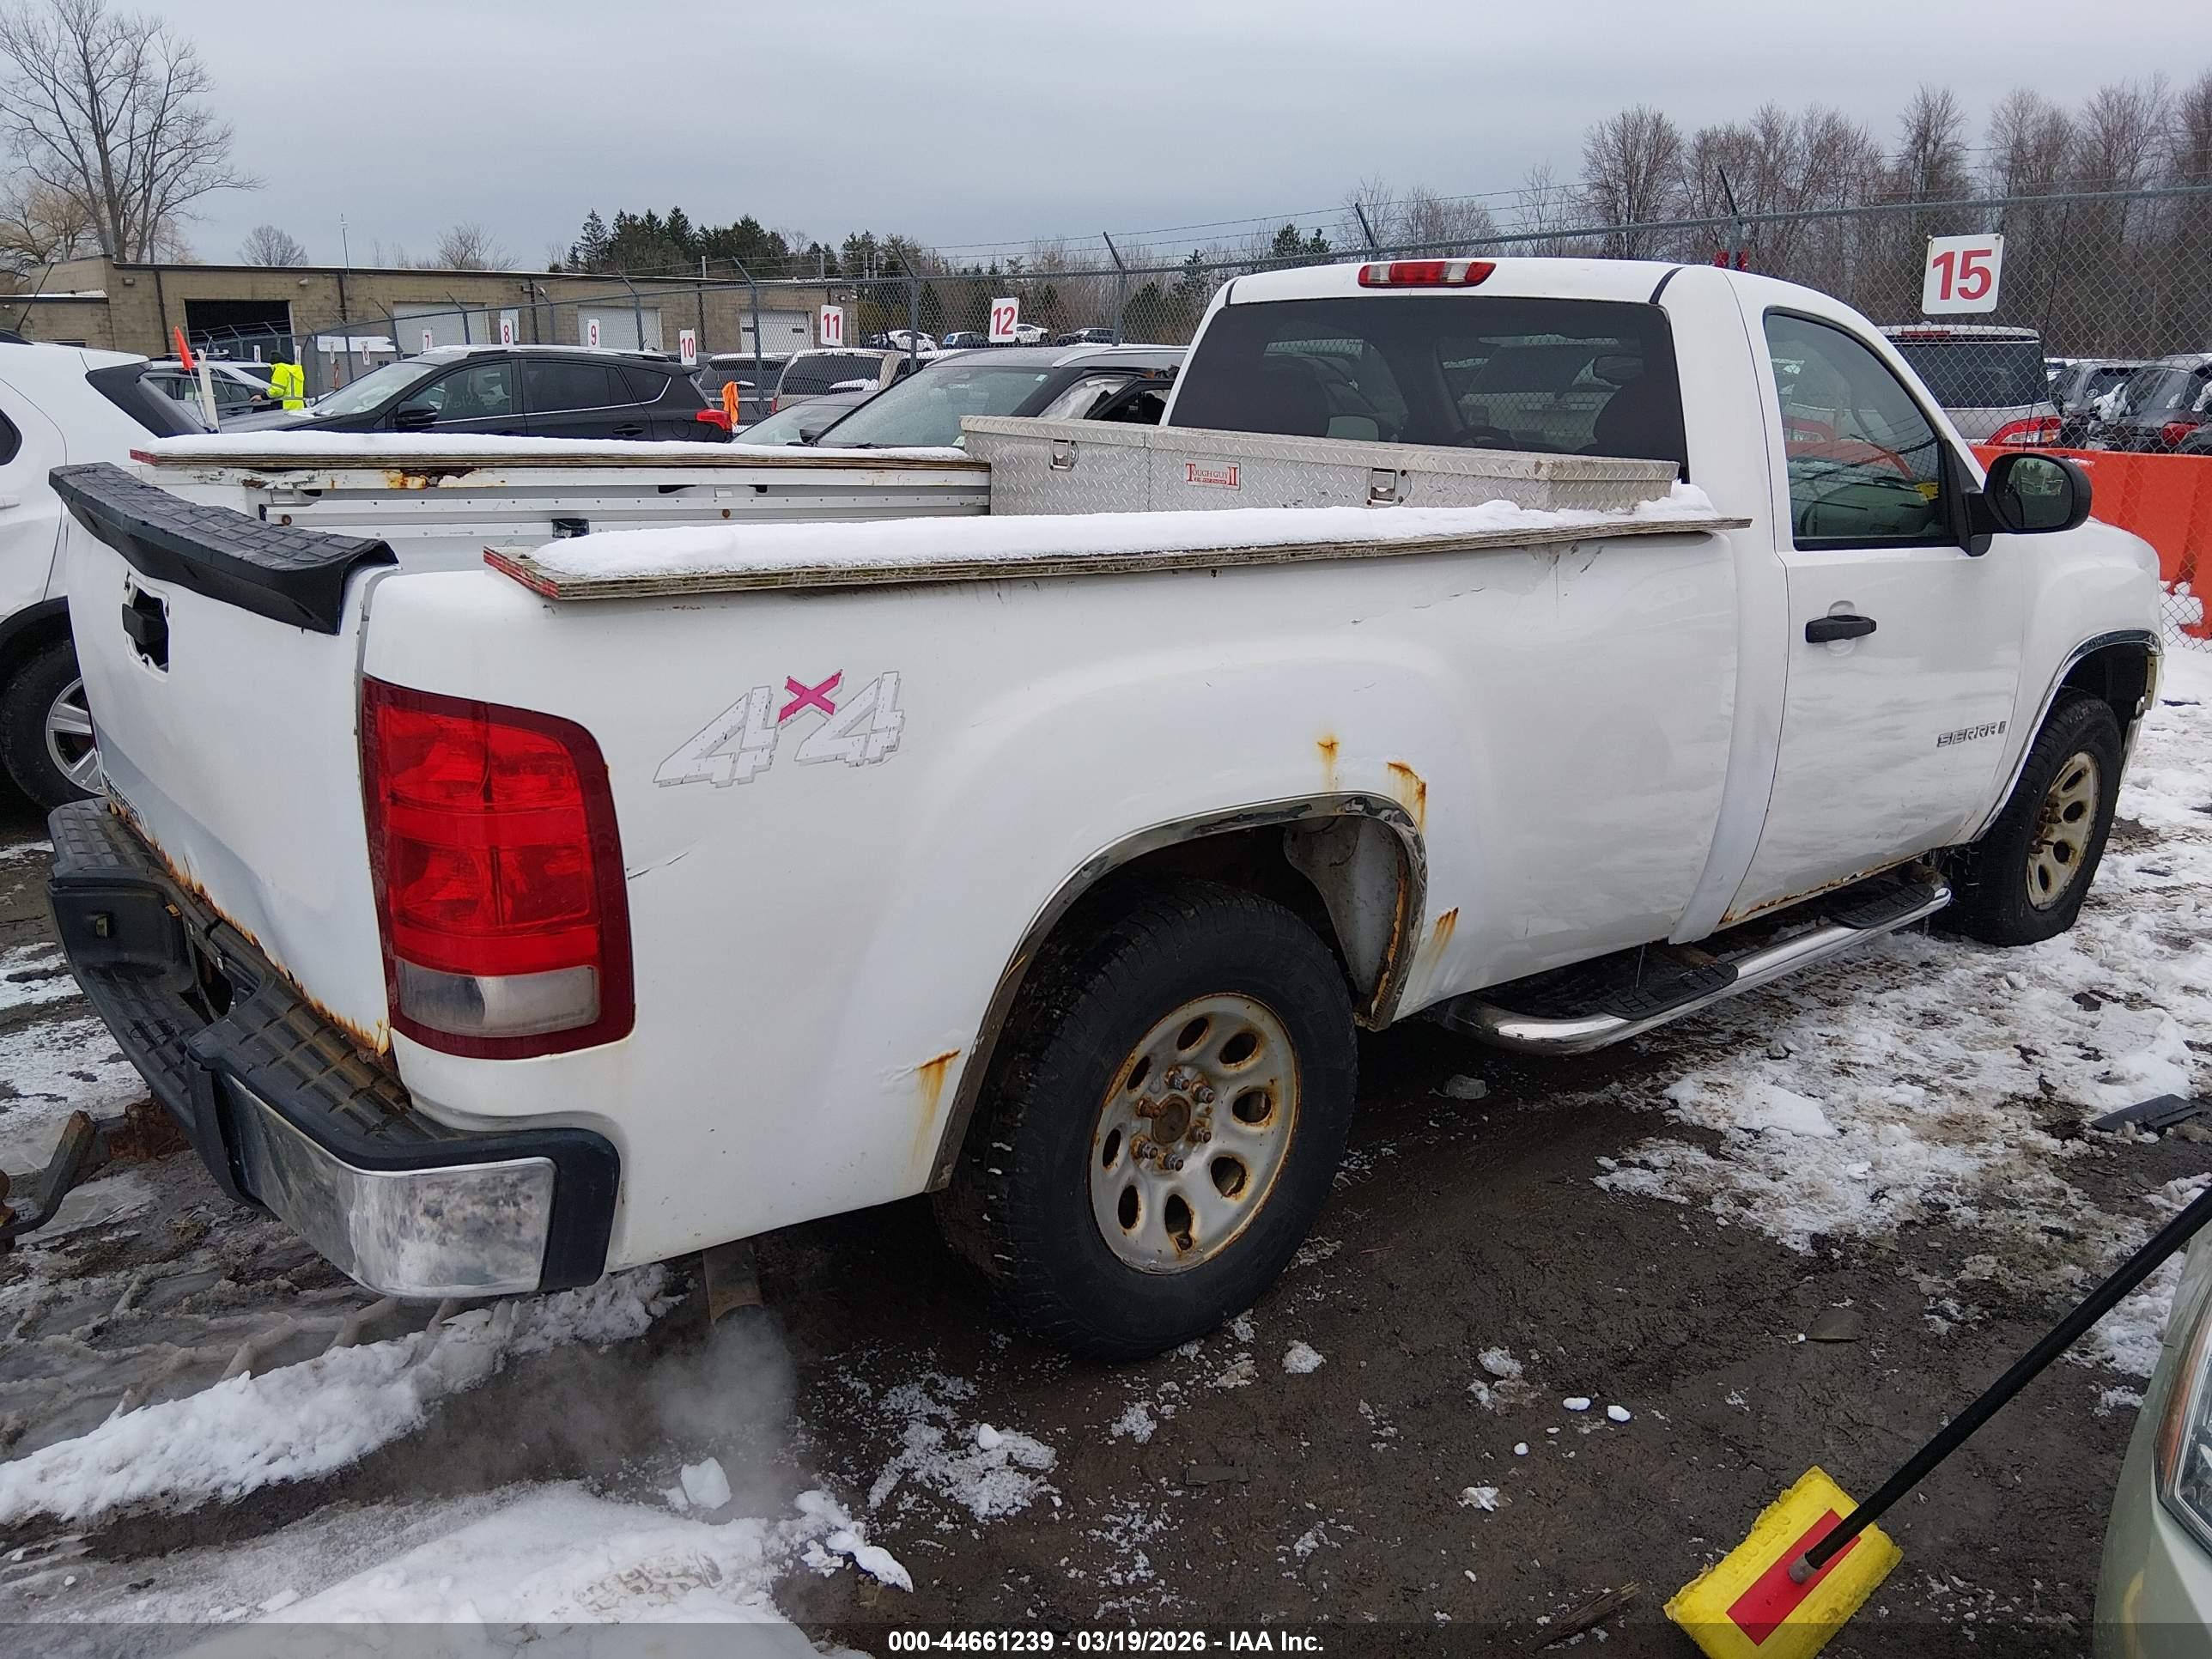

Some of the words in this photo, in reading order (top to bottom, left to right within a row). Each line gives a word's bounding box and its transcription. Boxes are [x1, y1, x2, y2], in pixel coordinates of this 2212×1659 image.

[1932, 249, 1992, 301] 15
[823, 313, 841, 340] 11
[993, 306, 1017, 336] 12
[424, 334, 430, 349] 7
[503, 325, 510, 343] 8
[591, 325, 597, 345] 9
[681, 337, 695, 358] 10
